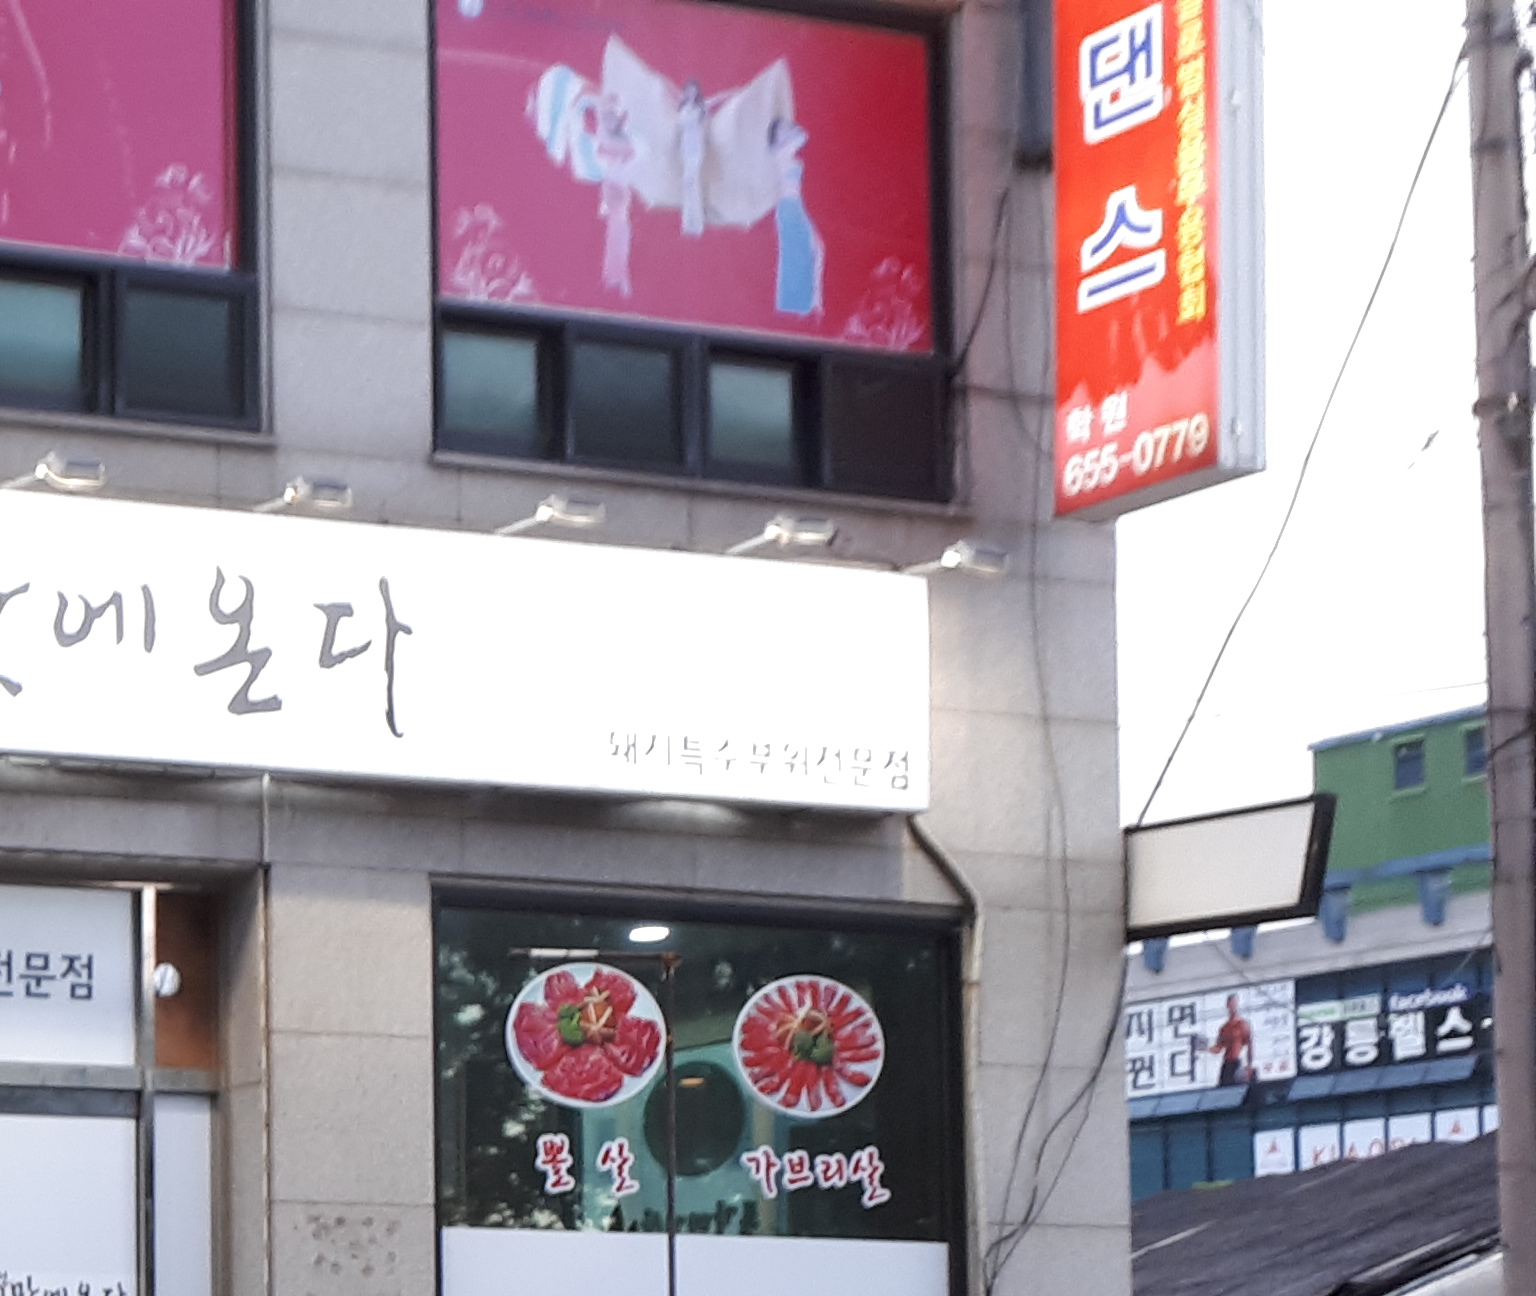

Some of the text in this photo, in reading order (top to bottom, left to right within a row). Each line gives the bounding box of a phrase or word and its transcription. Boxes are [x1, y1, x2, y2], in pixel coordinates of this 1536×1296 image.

[1077, 3, 1167, 313] 댄스
[1062, 412, 1210, 496] 655-0779
[740, 1144, 891, 1210] 가브리살
